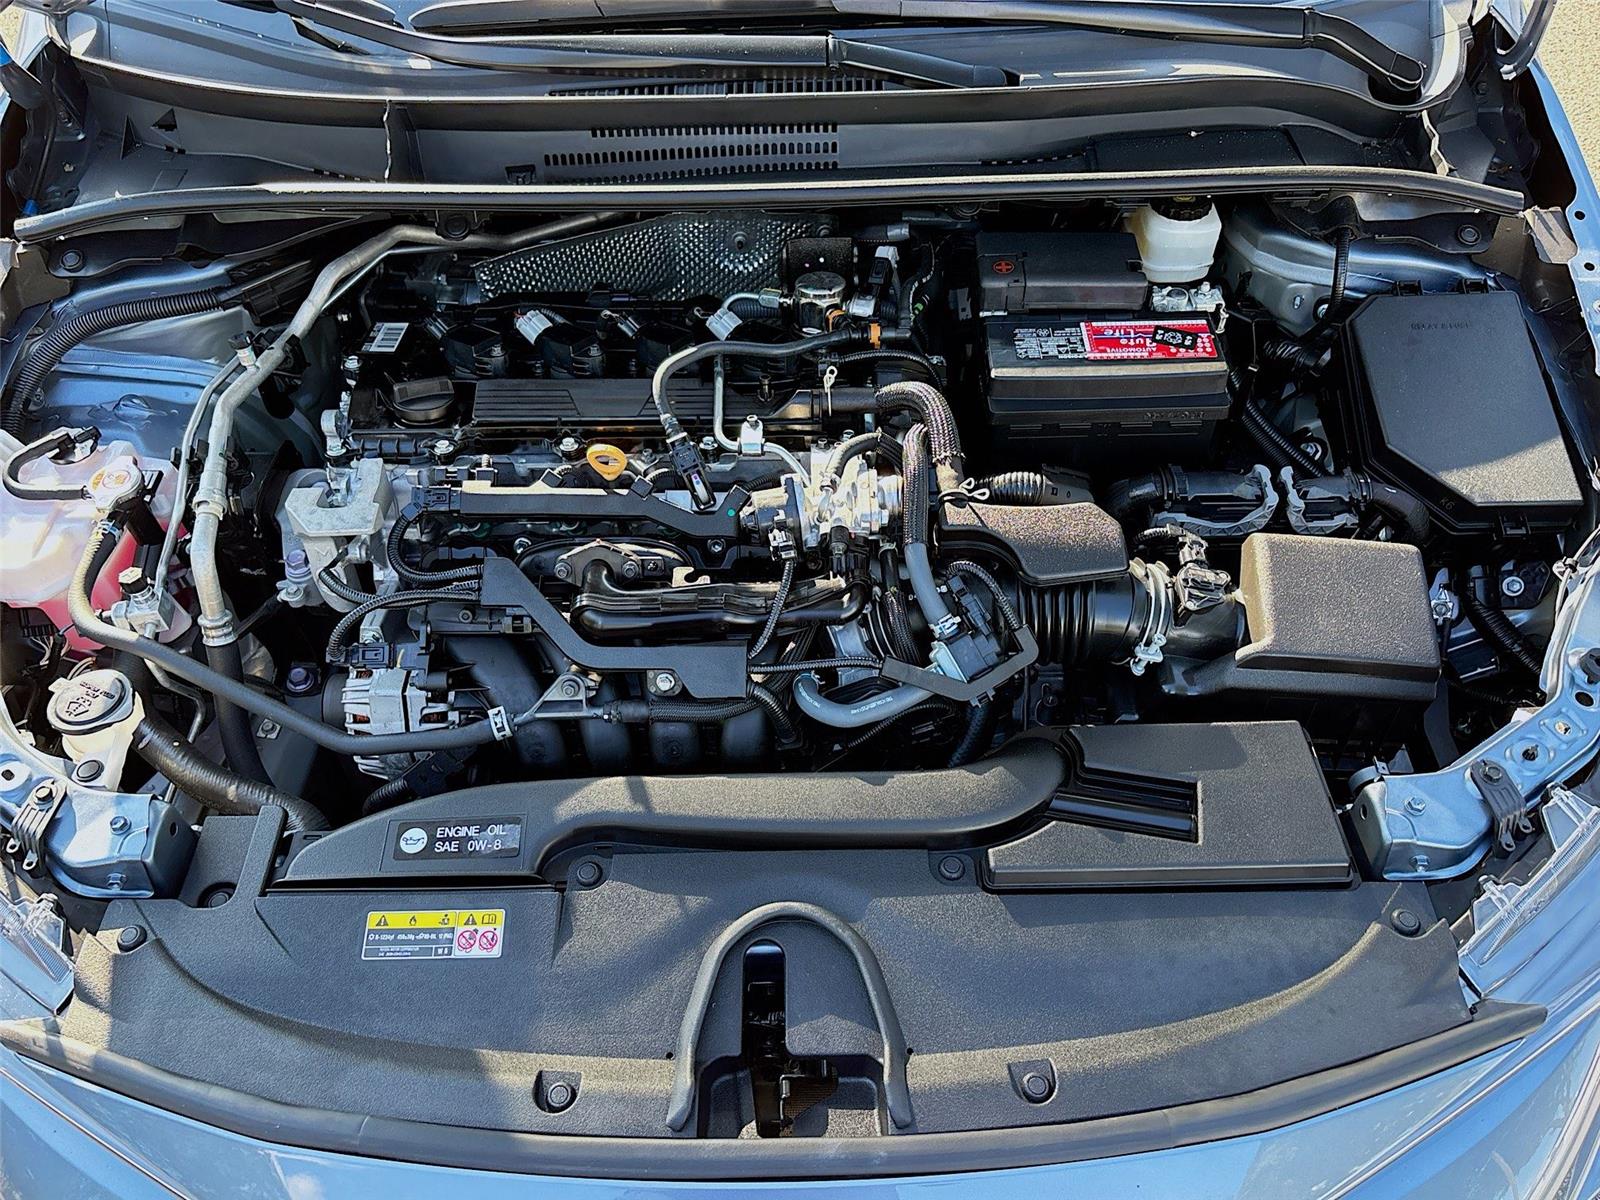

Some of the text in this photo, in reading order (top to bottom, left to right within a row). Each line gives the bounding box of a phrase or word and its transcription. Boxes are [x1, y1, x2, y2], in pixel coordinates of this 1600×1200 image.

[436, 824, 507, 838] ENGINE OIL
[434, 839, 502, 852] SAE 0W-8
